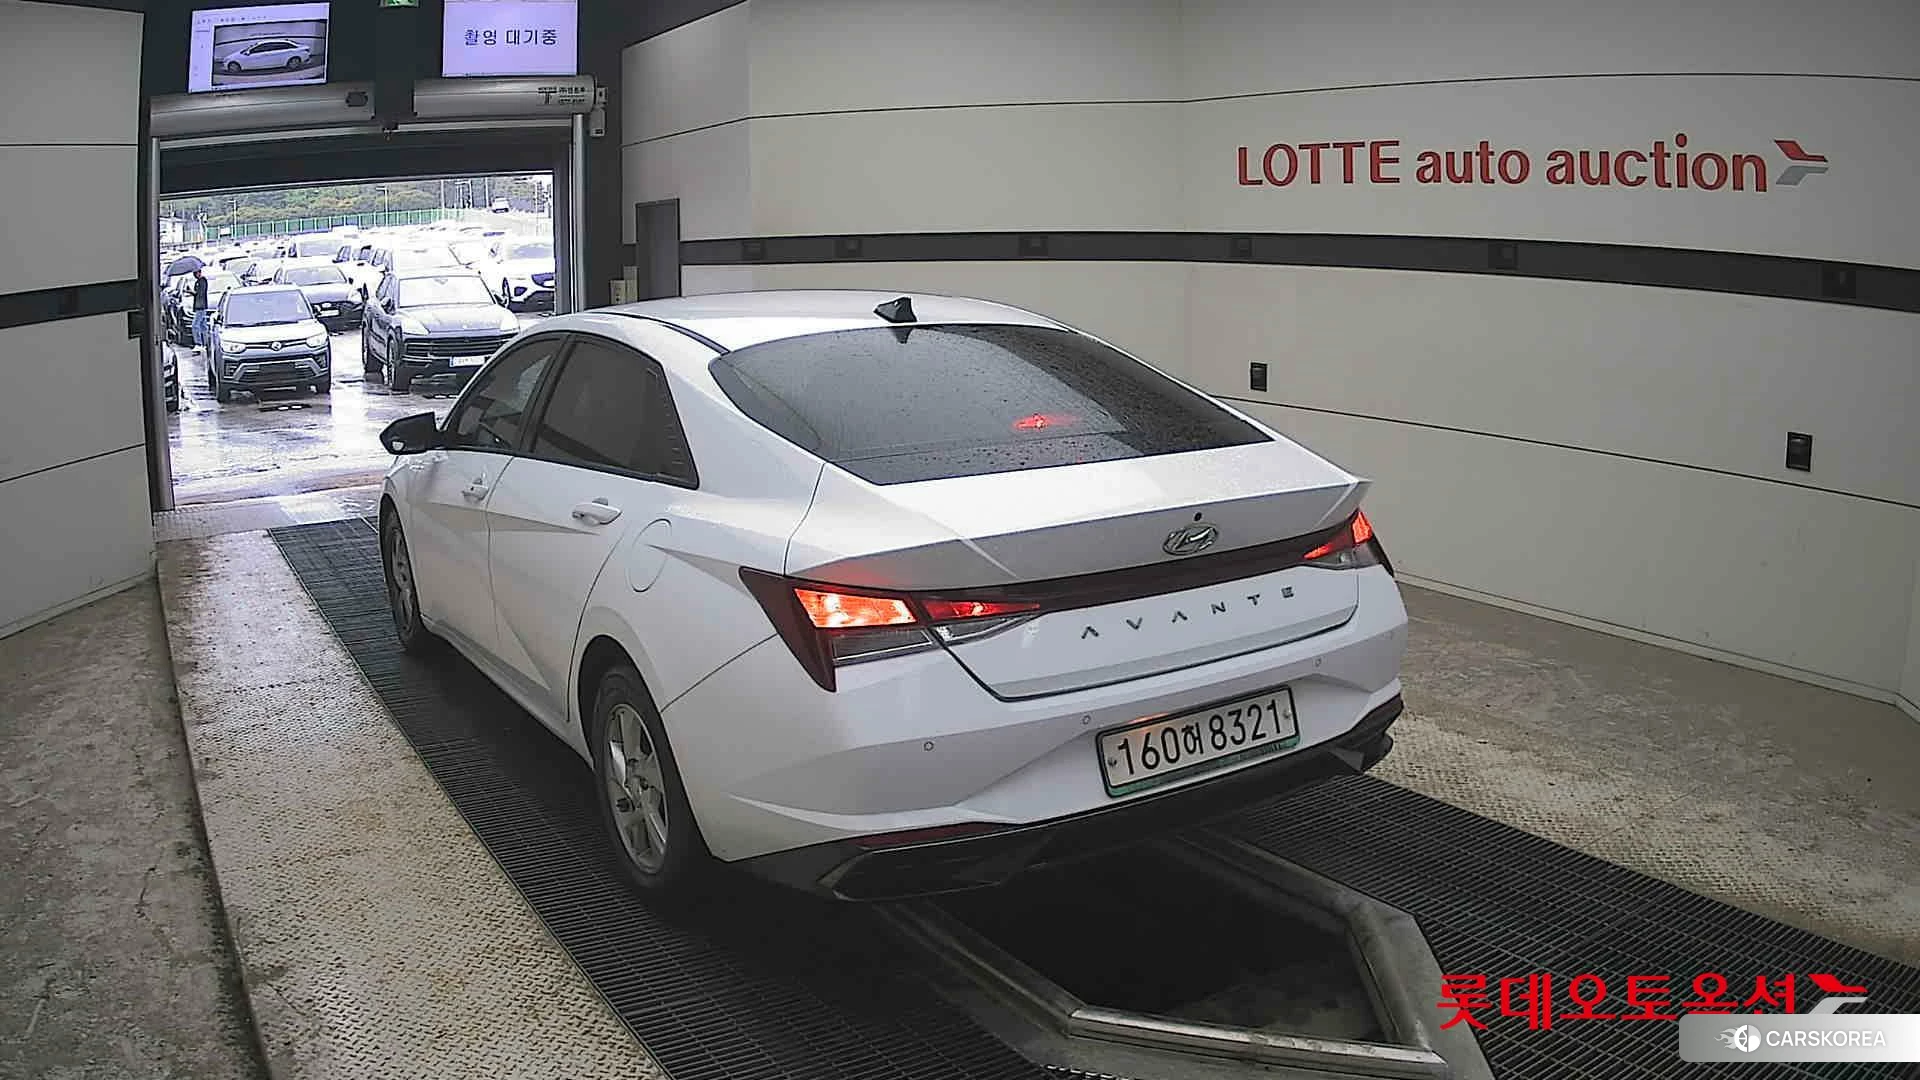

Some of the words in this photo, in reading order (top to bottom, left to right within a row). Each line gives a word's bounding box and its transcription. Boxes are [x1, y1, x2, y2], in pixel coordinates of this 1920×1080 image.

[505, 29, 558, 46] 대기중
[1237, 139, 1400, 186] LOTTE
[1415, 140, 1530, 185] auto
[1546, 133, 1767, 192] auction
[1081, 586, 1295, 640] AVANTE
